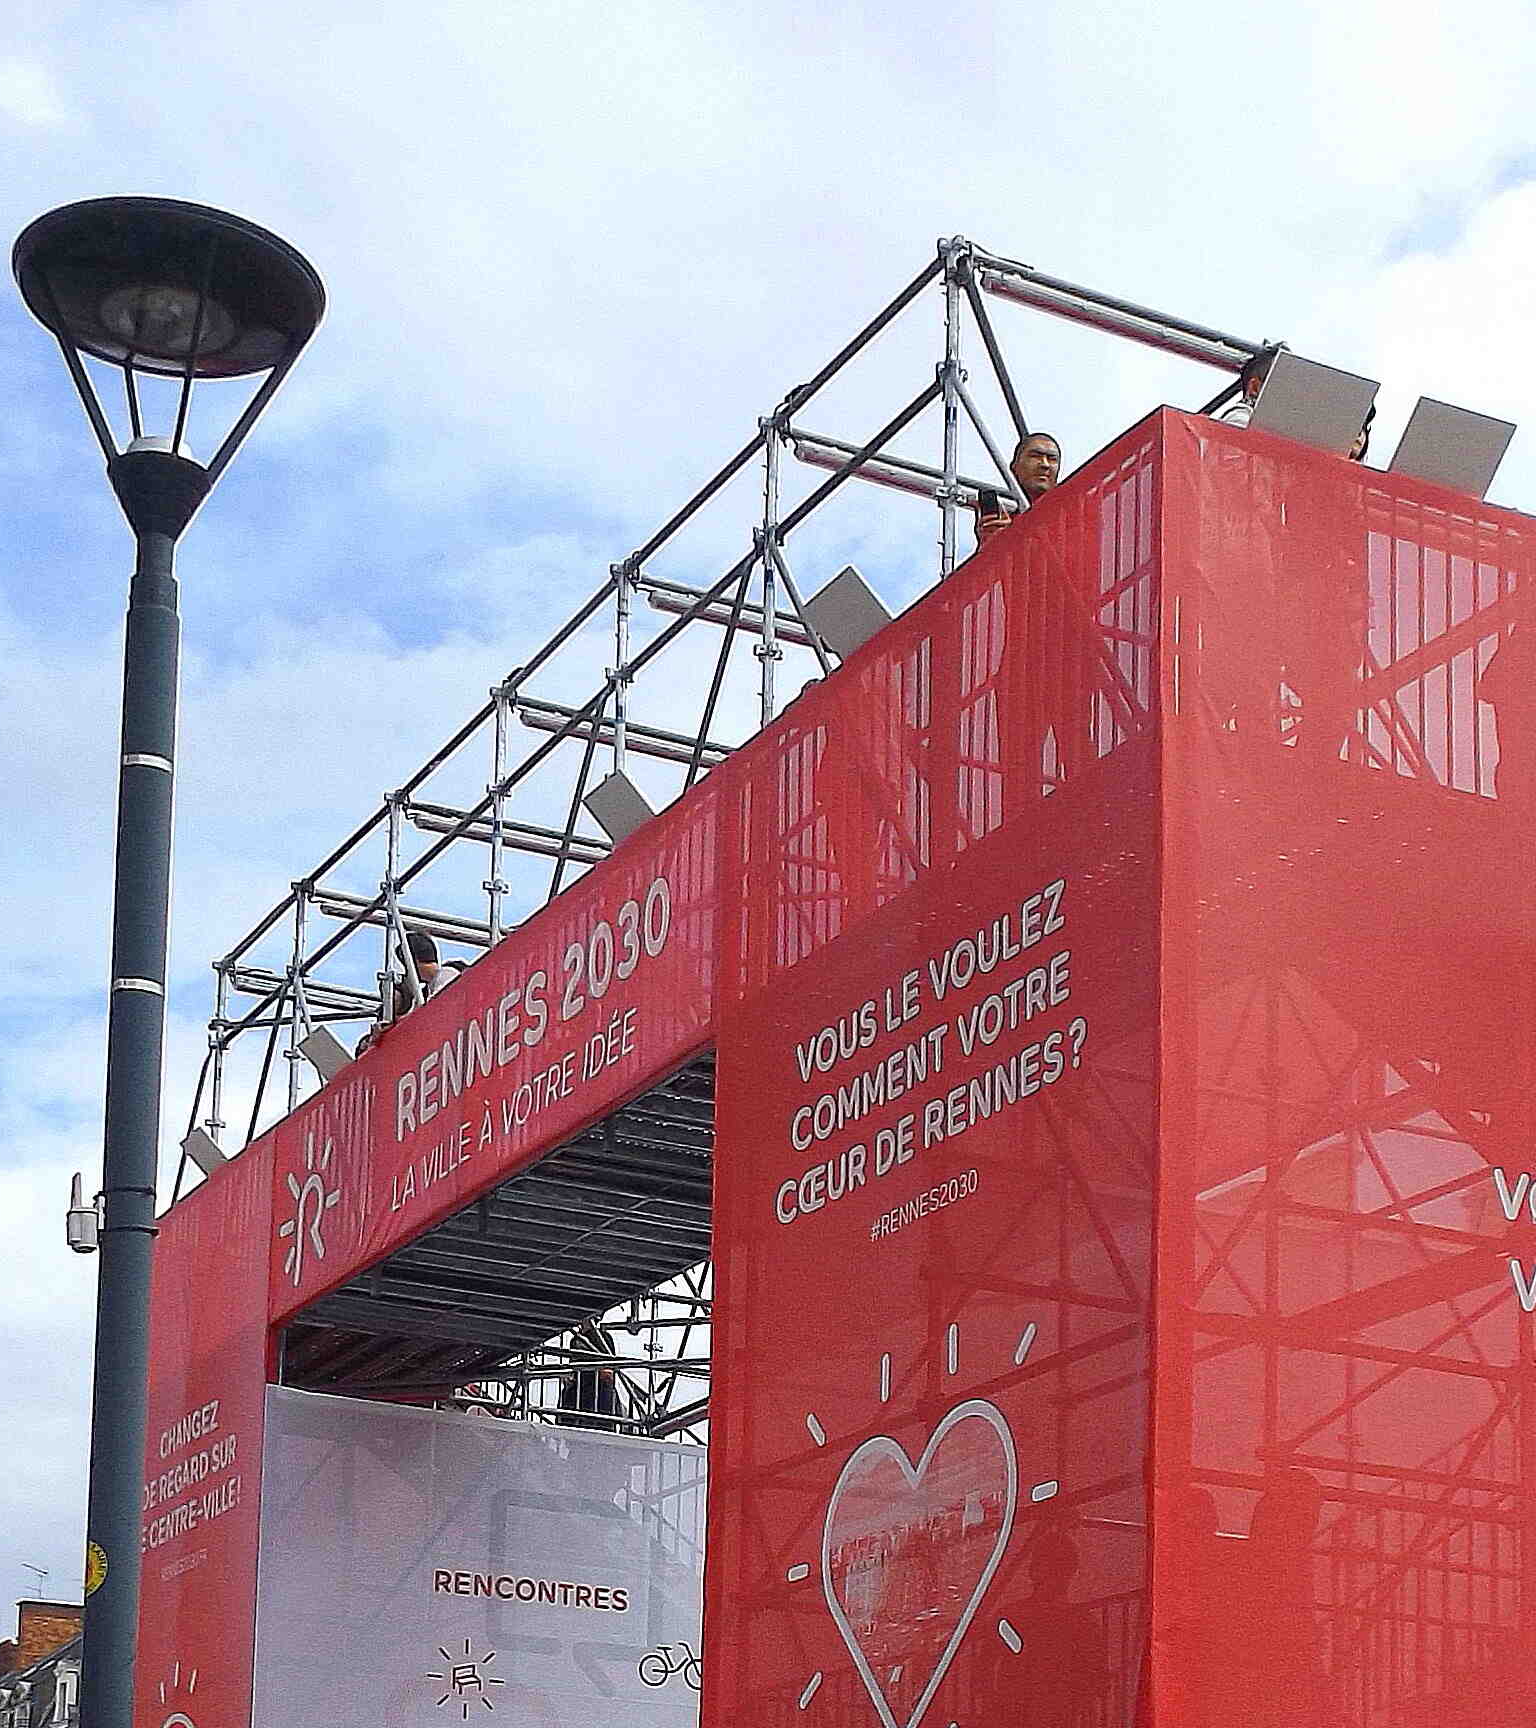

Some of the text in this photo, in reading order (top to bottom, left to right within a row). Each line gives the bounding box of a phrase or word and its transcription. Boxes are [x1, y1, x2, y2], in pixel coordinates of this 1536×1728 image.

[396, 877, 671, 1142] RENNES 2030
[794, 878, 1066, 1083] VOUS LE VOULEZ
[790, 950, 1071, 1152] COMMENT VOTRE
[390, 1006, 638, 1212] LA VILLE À VOTRE IDÉE
[775, 1144, 867, 1224] CŒUR
[875, 1113, 915, 1178] DE
[869, 1168, 979, 1242] #RENNES2030
[159, 1399, 221, 1459] CHANGEZ
[159, 1450, 209, 1503] REGARD
[211, 1434, 237, 1473] SUR
[434, 1569, 629, 1612] RENCONTRES
